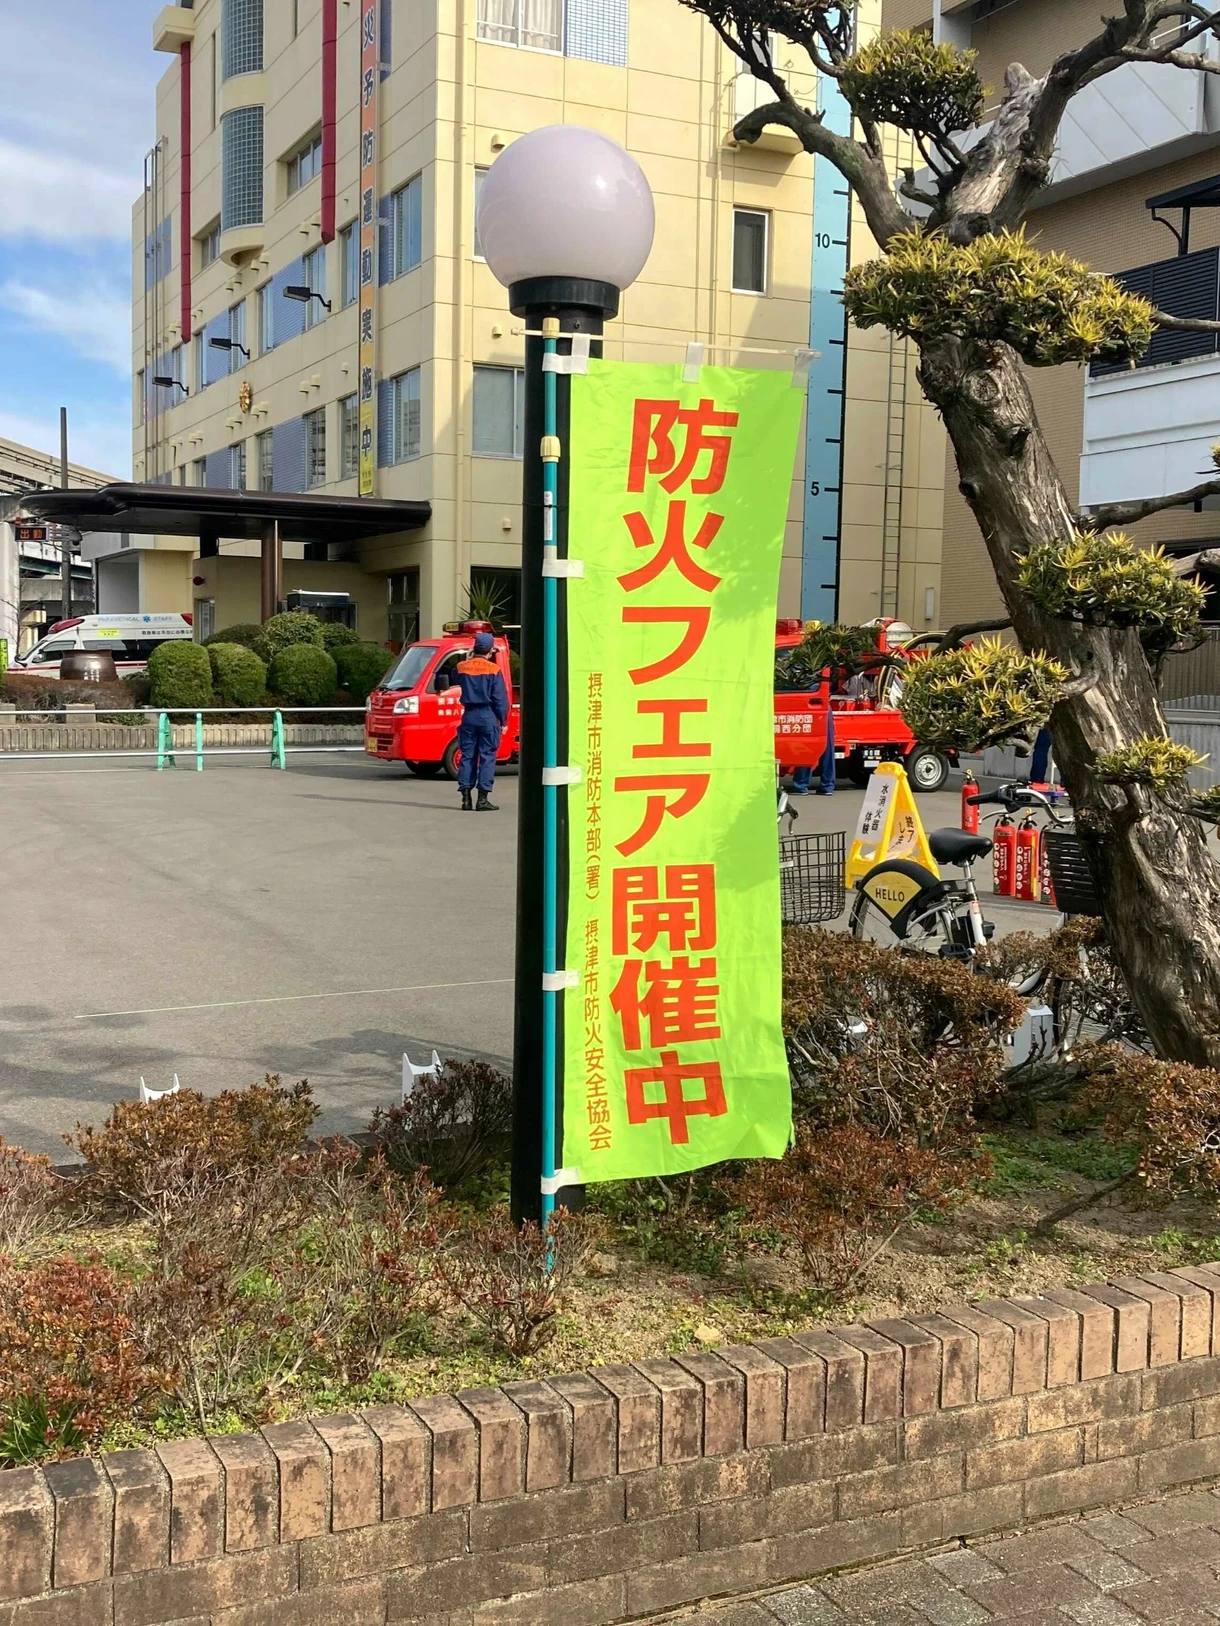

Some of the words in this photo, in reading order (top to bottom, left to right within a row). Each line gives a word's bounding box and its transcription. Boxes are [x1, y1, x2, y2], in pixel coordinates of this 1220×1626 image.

[815, 233, 830, 249] 10
[811, 481, 820, 497] 5
[609, 398, 740, 1145] 防火フェア開催中
[871, 783, 889, 831] 水消火器
[862, 810, 873, 835] 体験
[905, 815, 915, 843] 終了
[875, 887, 905, 902] HELLO
[584, 918, 613, 1151] 摂津市防火安全協会
